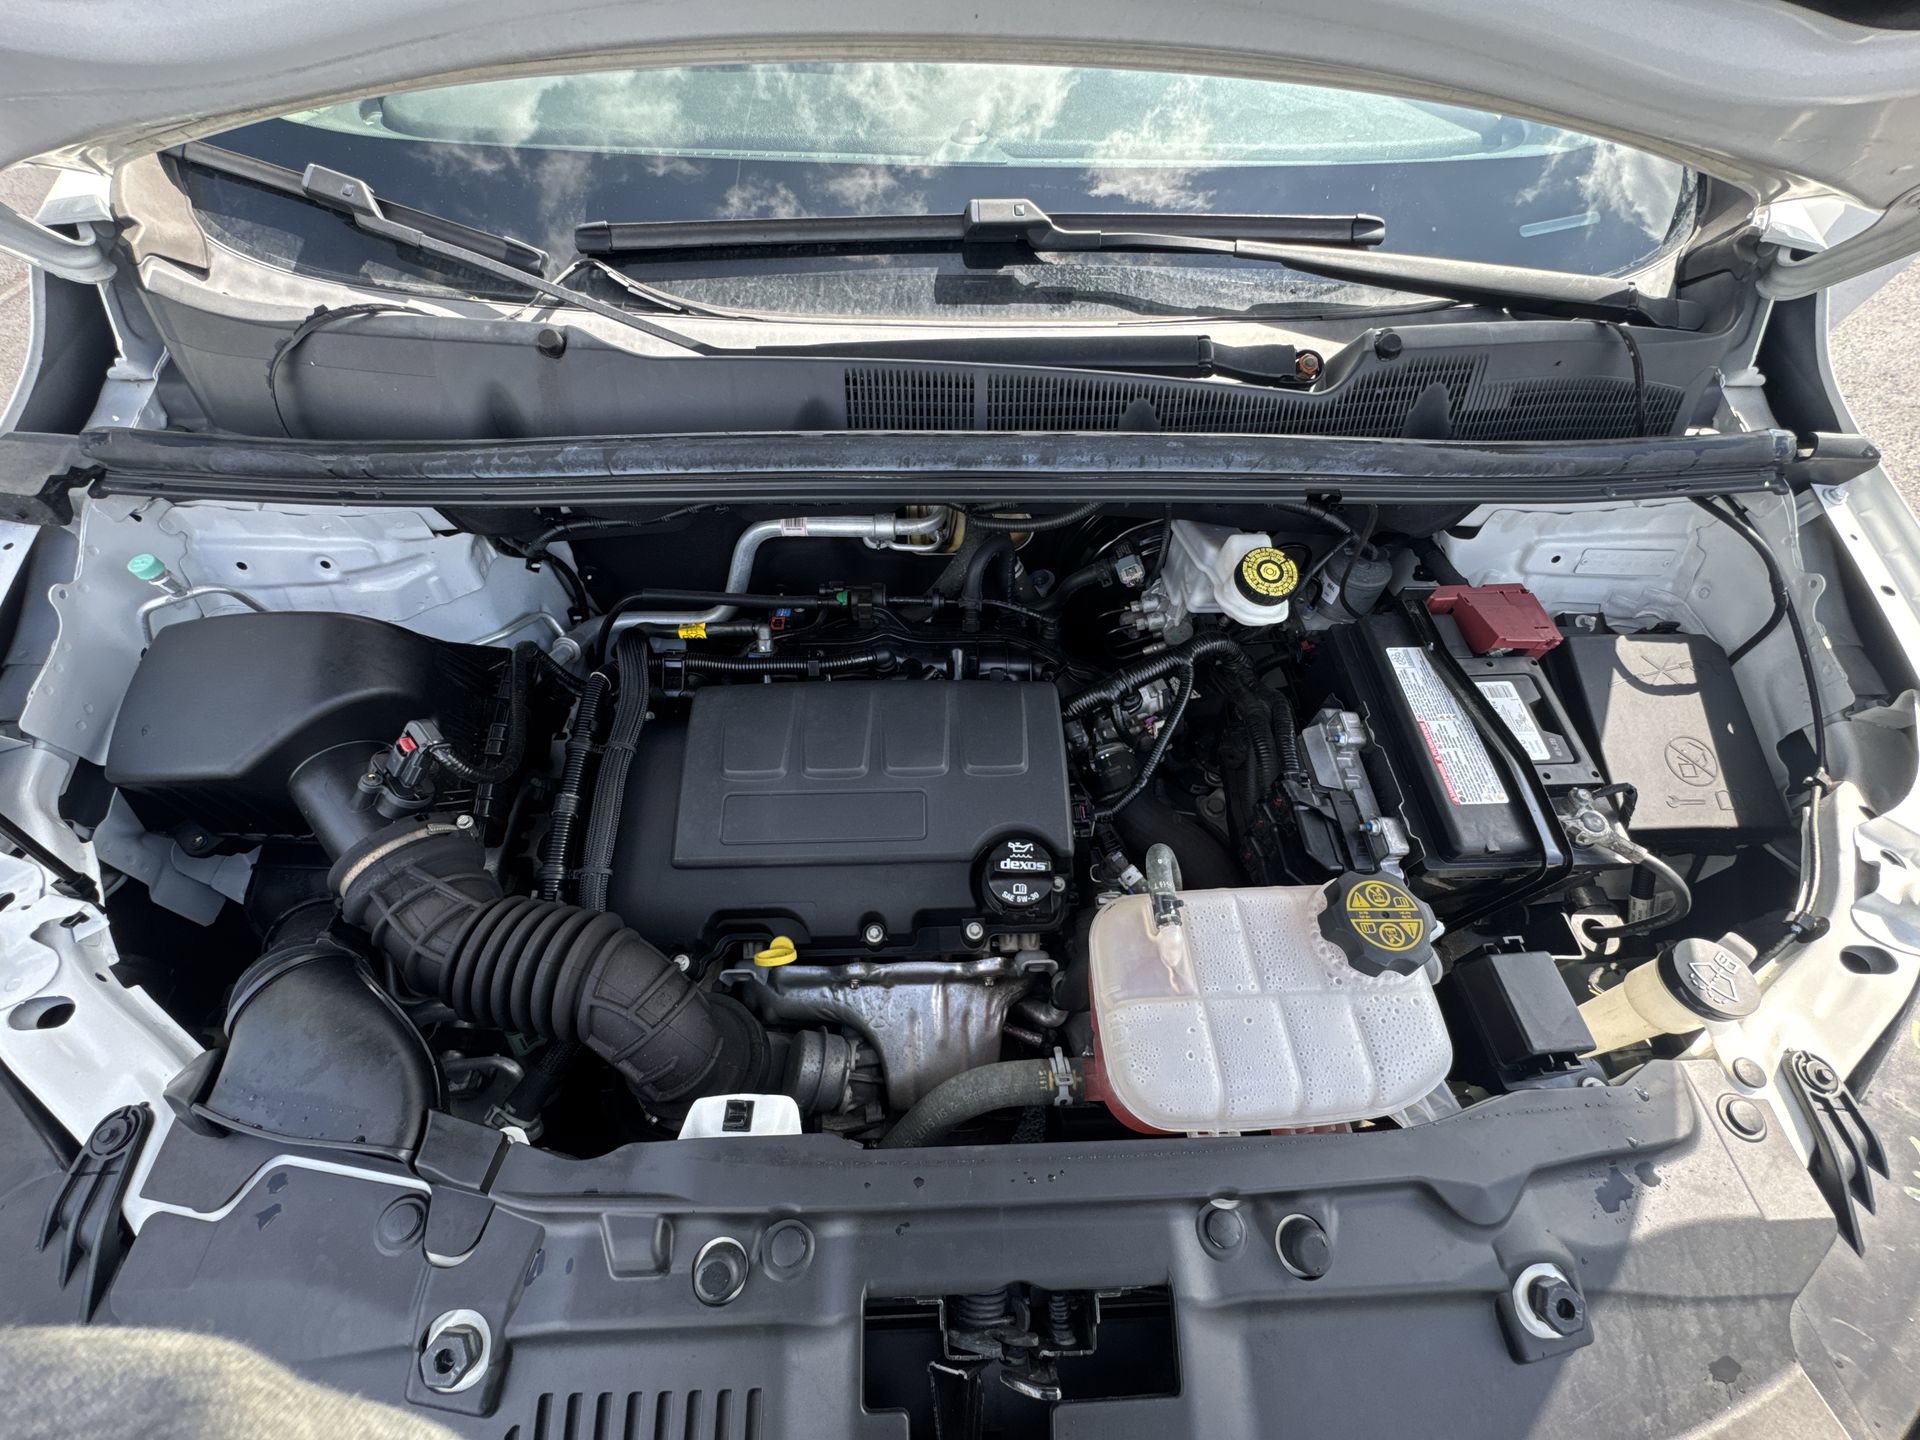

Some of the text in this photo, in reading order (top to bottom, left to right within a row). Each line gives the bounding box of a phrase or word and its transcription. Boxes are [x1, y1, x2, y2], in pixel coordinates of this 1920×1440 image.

[1000, 858, 1047, 871] dexos
[1002, 891, 1039, 903] SAE 5W-30
